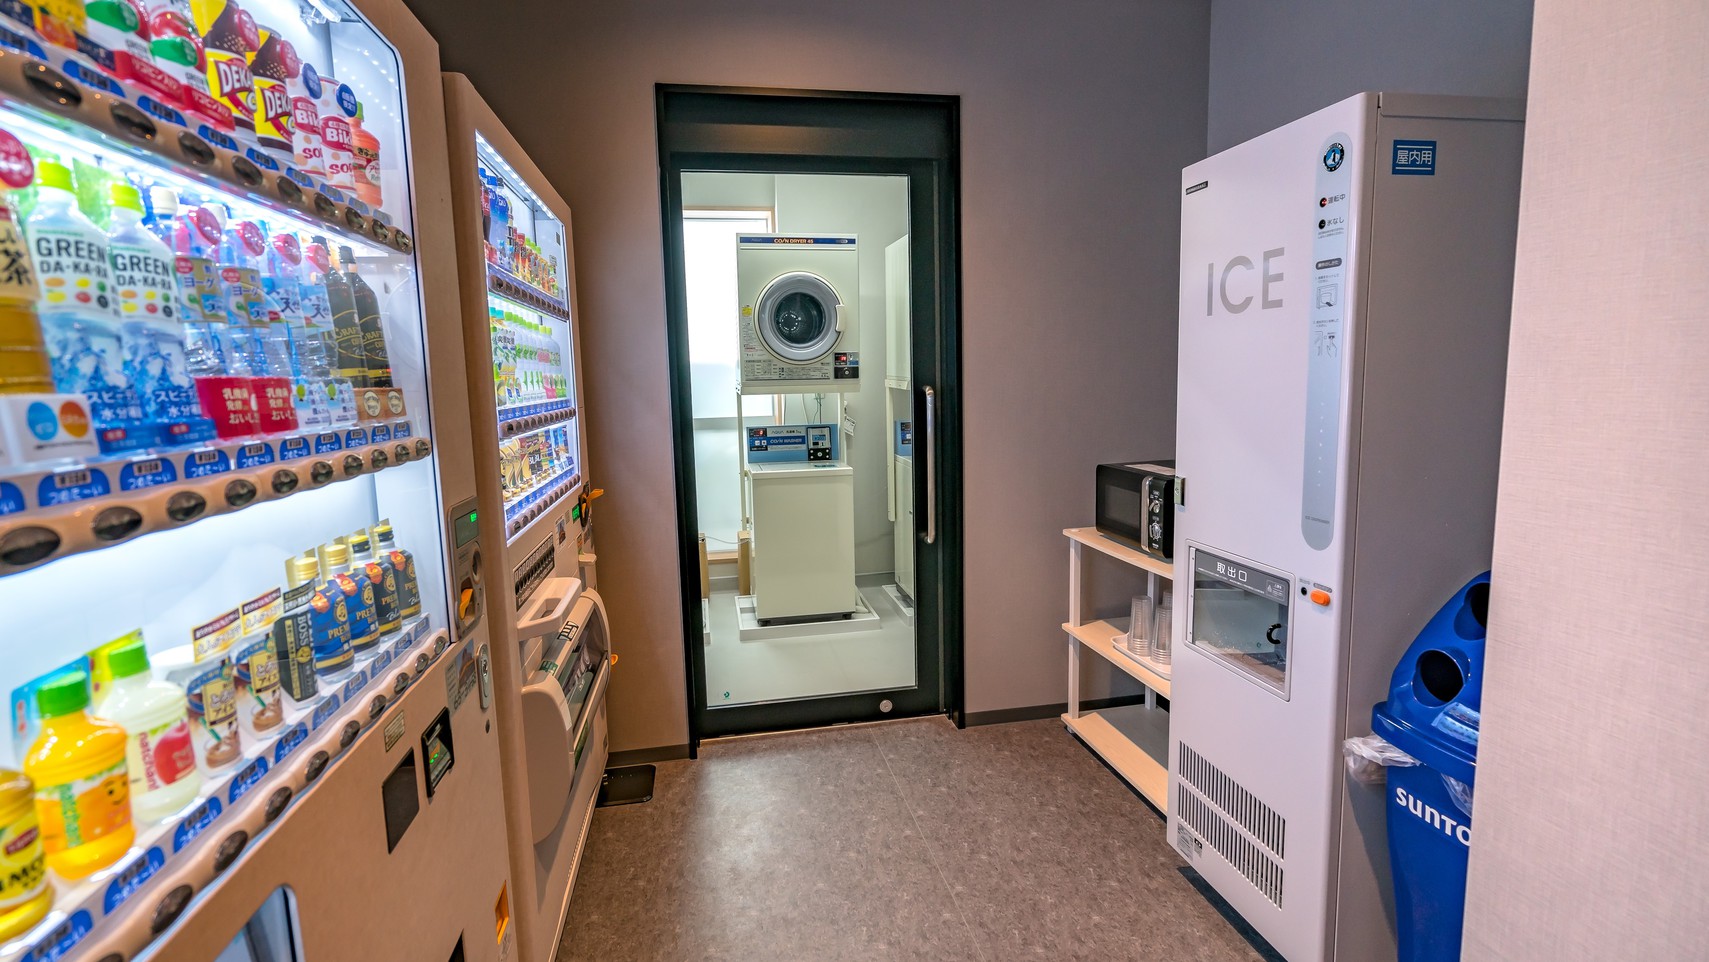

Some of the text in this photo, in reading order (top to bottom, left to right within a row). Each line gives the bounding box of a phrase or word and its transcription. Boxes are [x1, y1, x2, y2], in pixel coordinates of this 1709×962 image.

[1395, 150, 1433, 165] 屋内用
[1328, 193, 1346, 204] 運転中
[36, 237, 107, 265] GREEN
[114, 253, 170, 277] GREEN
[1206, 247, 1285, 317] ICE
[1216, 561, 1248, 582] 取出口
[298, 615, 309, 646] BOSS
